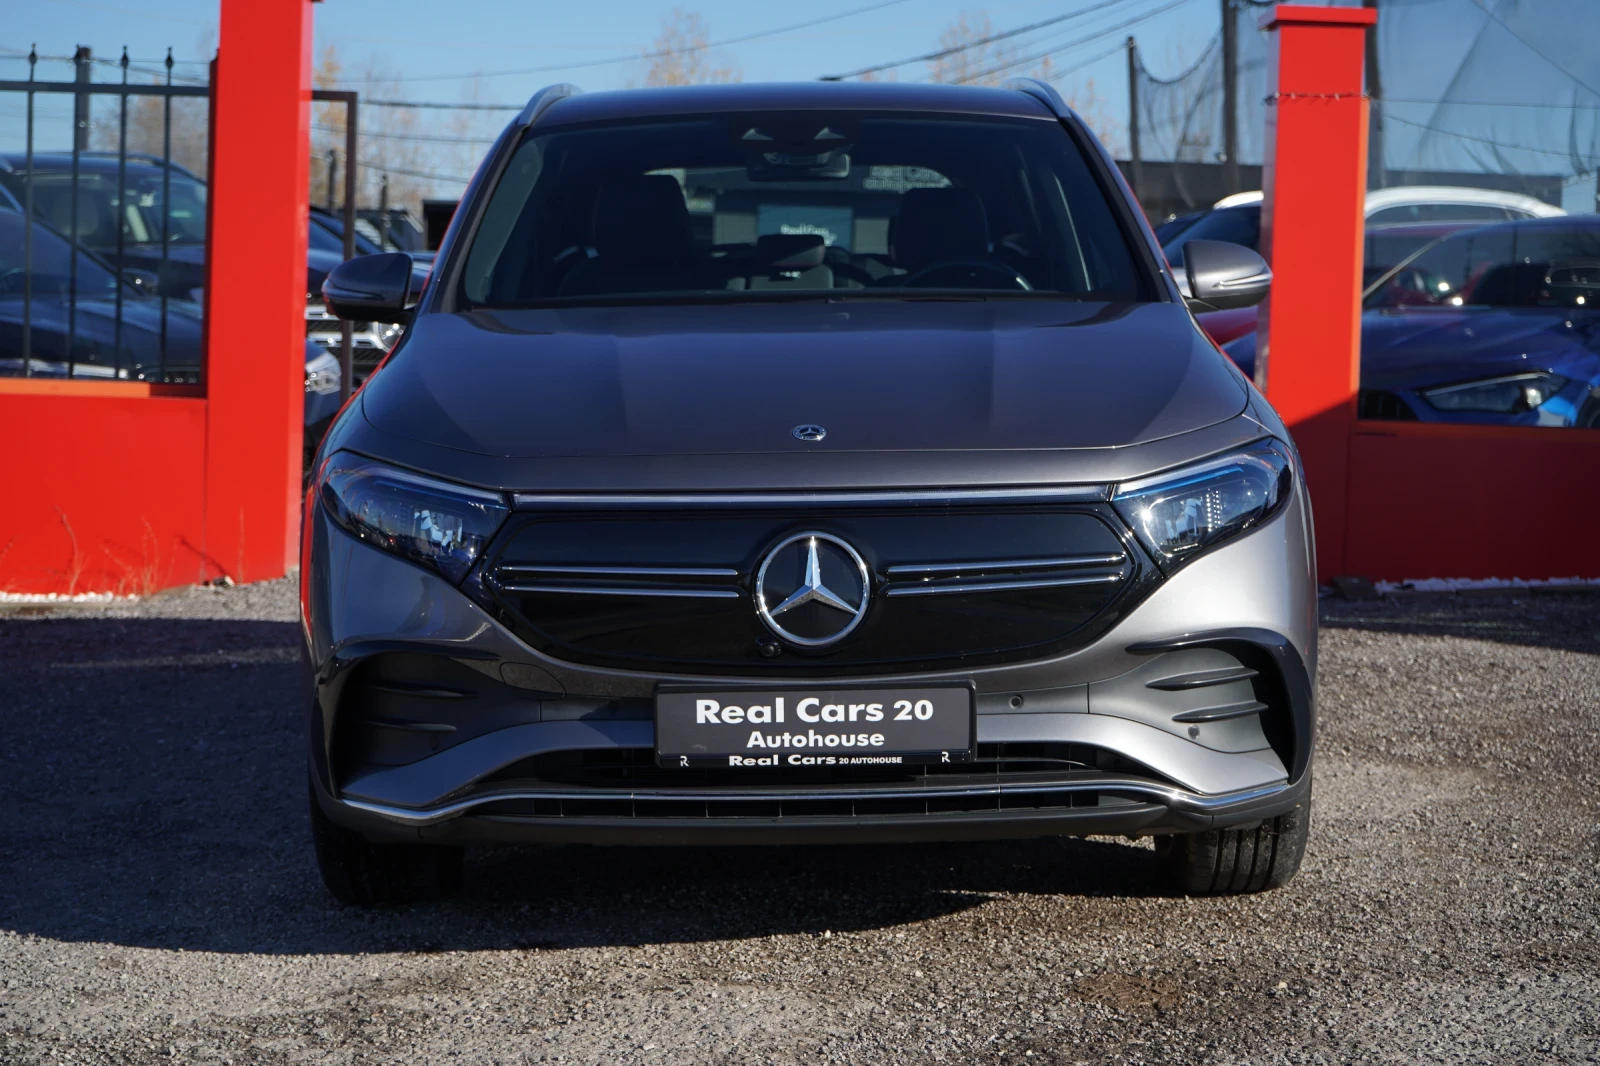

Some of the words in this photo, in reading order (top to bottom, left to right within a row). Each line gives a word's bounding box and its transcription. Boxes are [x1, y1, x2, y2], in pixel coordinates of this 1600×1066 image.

[695, 696, 785, 724] Real
[796, 697, 885, 723] Cars
[893, 699, 934, 721] 20
[746, 729, 885, 749] Autohouse
[728, 754, 779, 766] Real
[787, 754, 837, 765] Cars
[838, 757, 850, 765] 20
[850, 756, 903, 764] AUTOHOUSE
